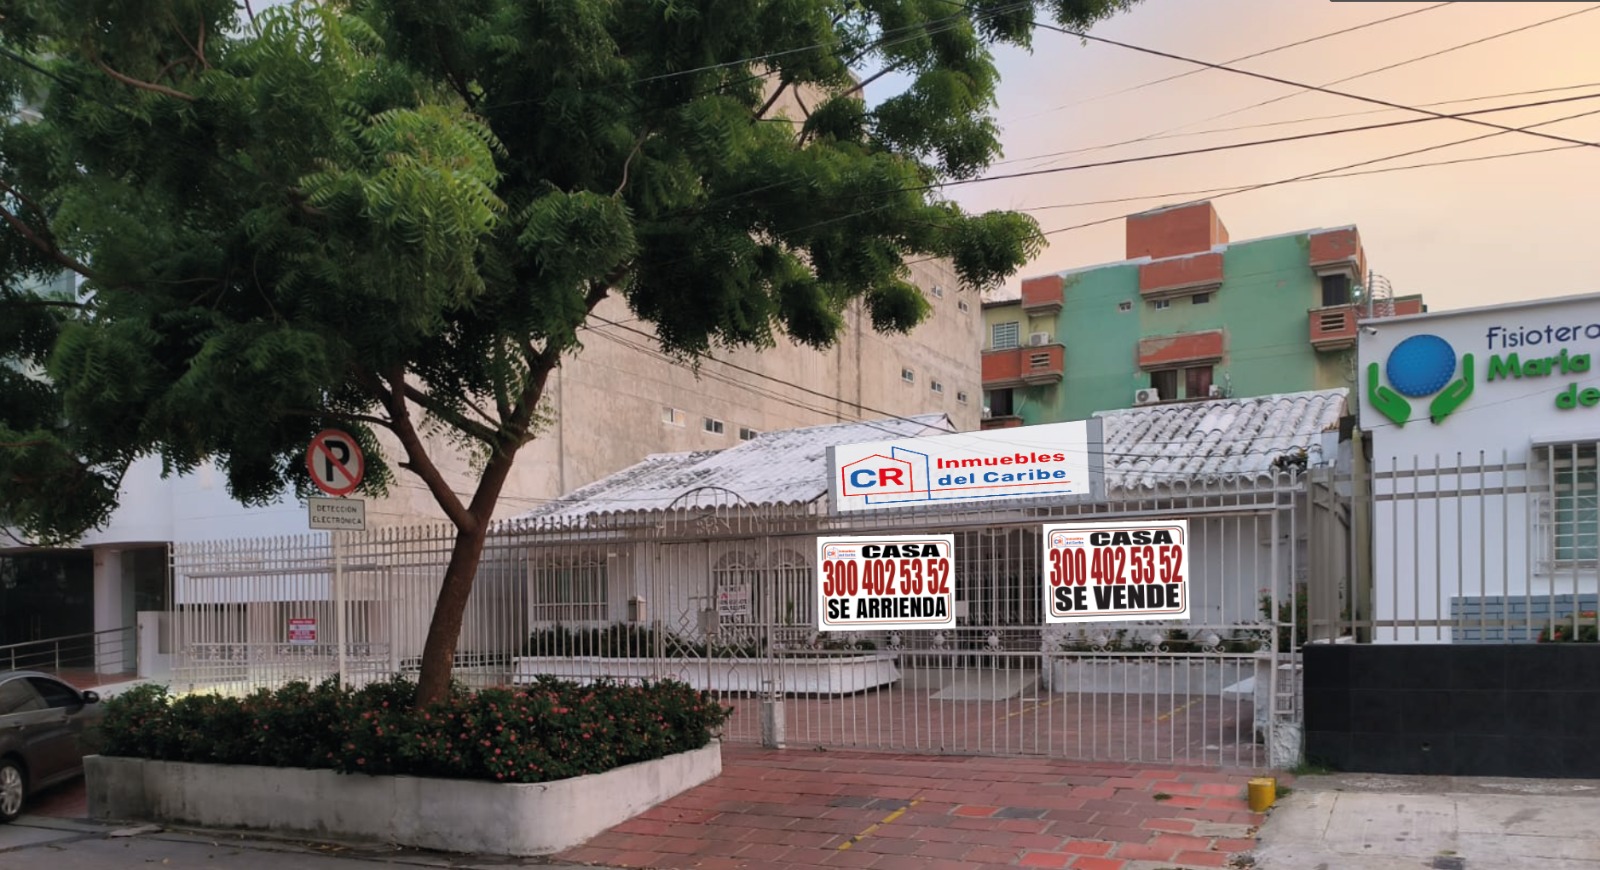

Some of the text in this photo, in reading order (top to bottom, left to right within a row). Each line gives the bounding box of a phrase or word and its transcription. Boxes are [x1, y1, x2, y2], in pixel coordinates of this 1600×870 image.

[1487, 348, 1591, 382] Maria
[324, 440, 350, 482] P
[937, 451, 1066, 470] Inmuebles
[850, 467, 904, 488] CR
[938, 468, 1067, 487] del Caribe
[1089, 530, 1173, 547] CASA
[861, 544, 941, 559] CASA
[823, 557, 950, 597] 300 402 53 52
[1050, 544, 1183, 587] 300 402 53 52
[828, 596, 947, 620] SE ARRIENDA
[1055, 583, 1180, 612] SE VENDE
